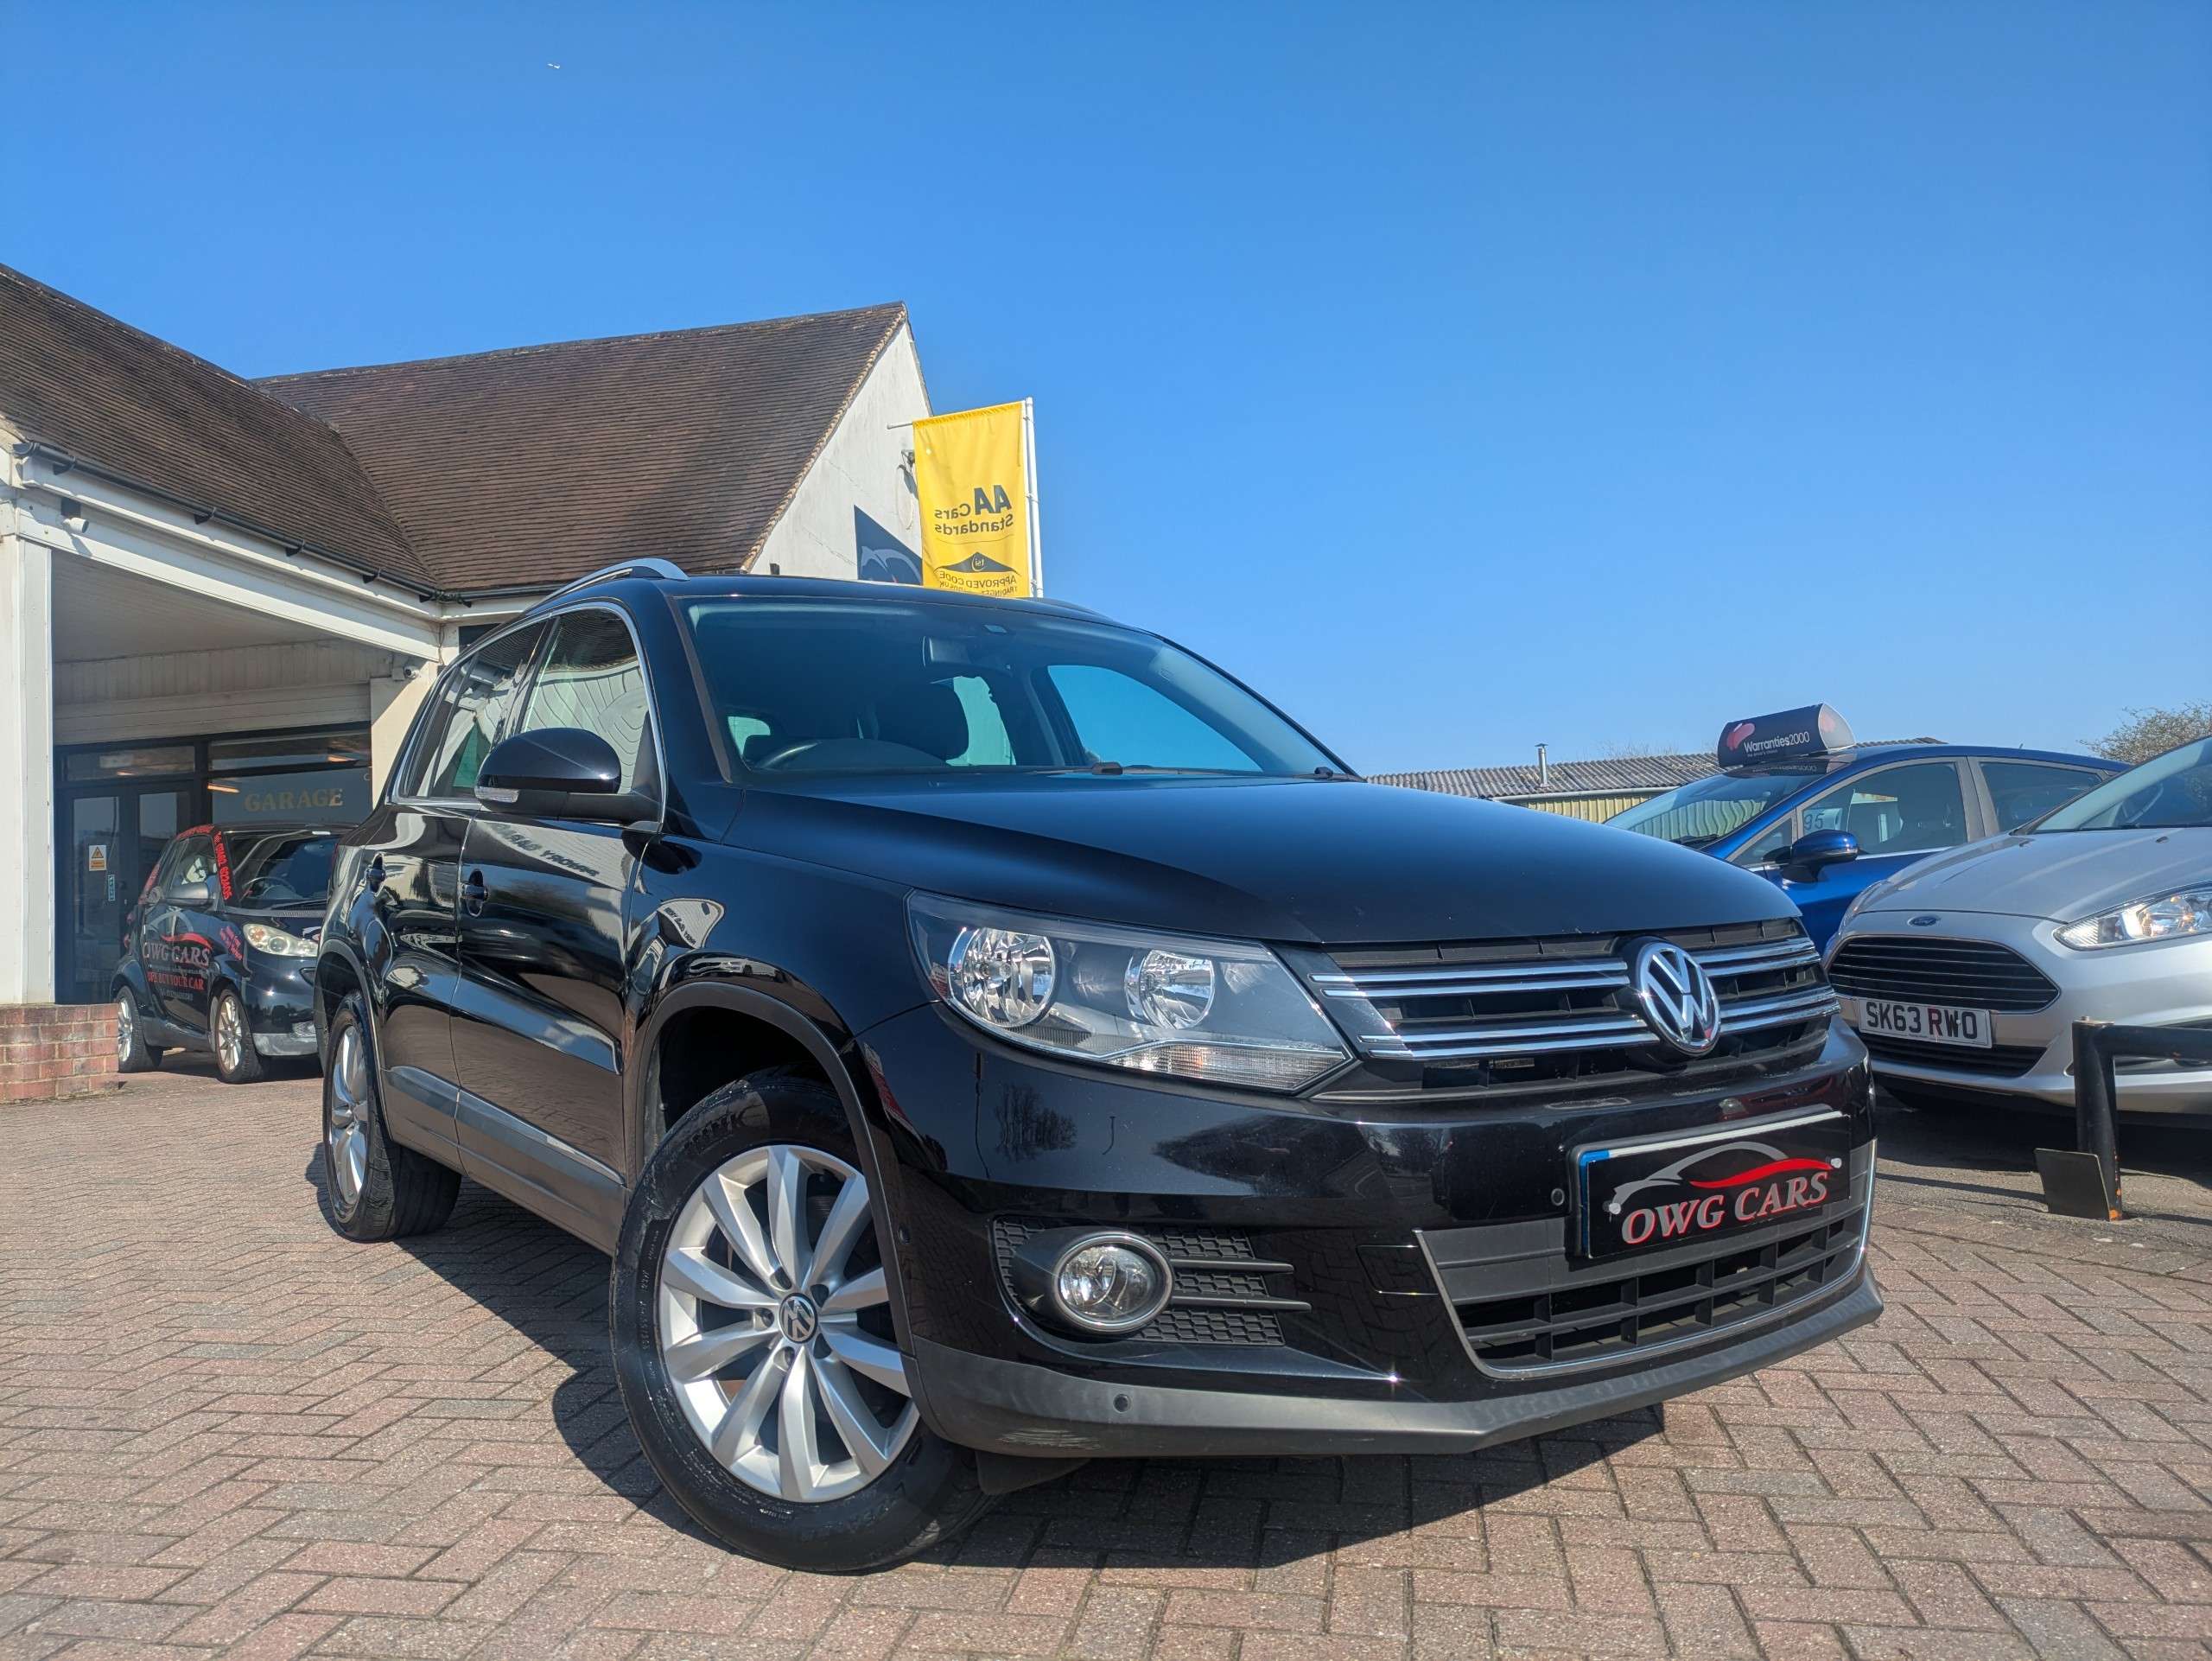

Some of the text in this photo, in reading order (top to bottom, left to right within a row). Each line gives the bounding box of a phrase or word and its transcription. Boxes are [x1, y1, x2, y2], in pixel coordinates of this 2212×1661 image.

[1743, 731, 1810, 754] Warranties2000
[244, 788, 343, 811] GARAGE
[143, 942, 210, 968] OWG CARS
[1866, 1001, 1978, 1040] SK63 RWO
[1621, 1170, 1829, 1245] OWG CARS
